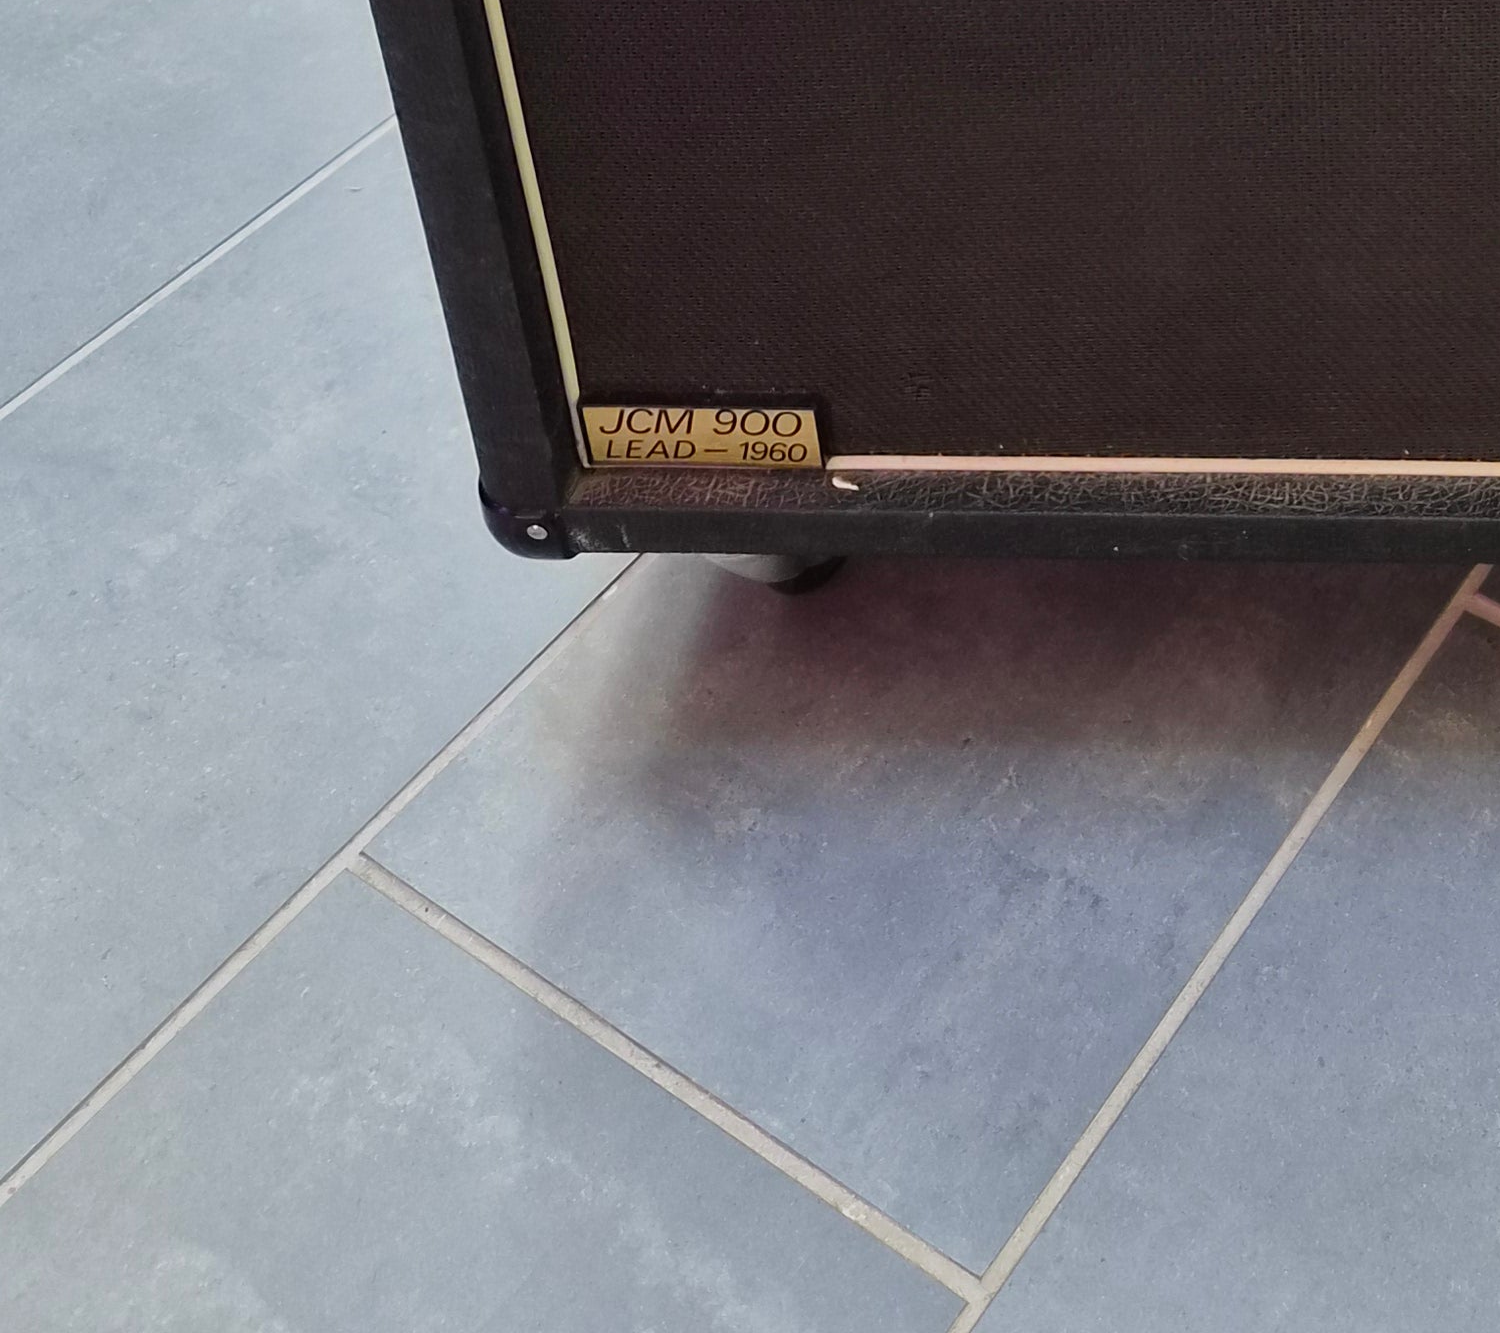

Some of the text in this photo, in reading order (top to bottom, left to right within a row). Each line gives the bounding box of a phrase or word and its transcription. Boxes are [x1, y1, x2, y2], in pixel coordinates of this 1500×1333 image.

[598, 408, 803, 437] JCM 900
[605, 439, 697, 460] LEAD
[738, 441, 808, 463] 1960
